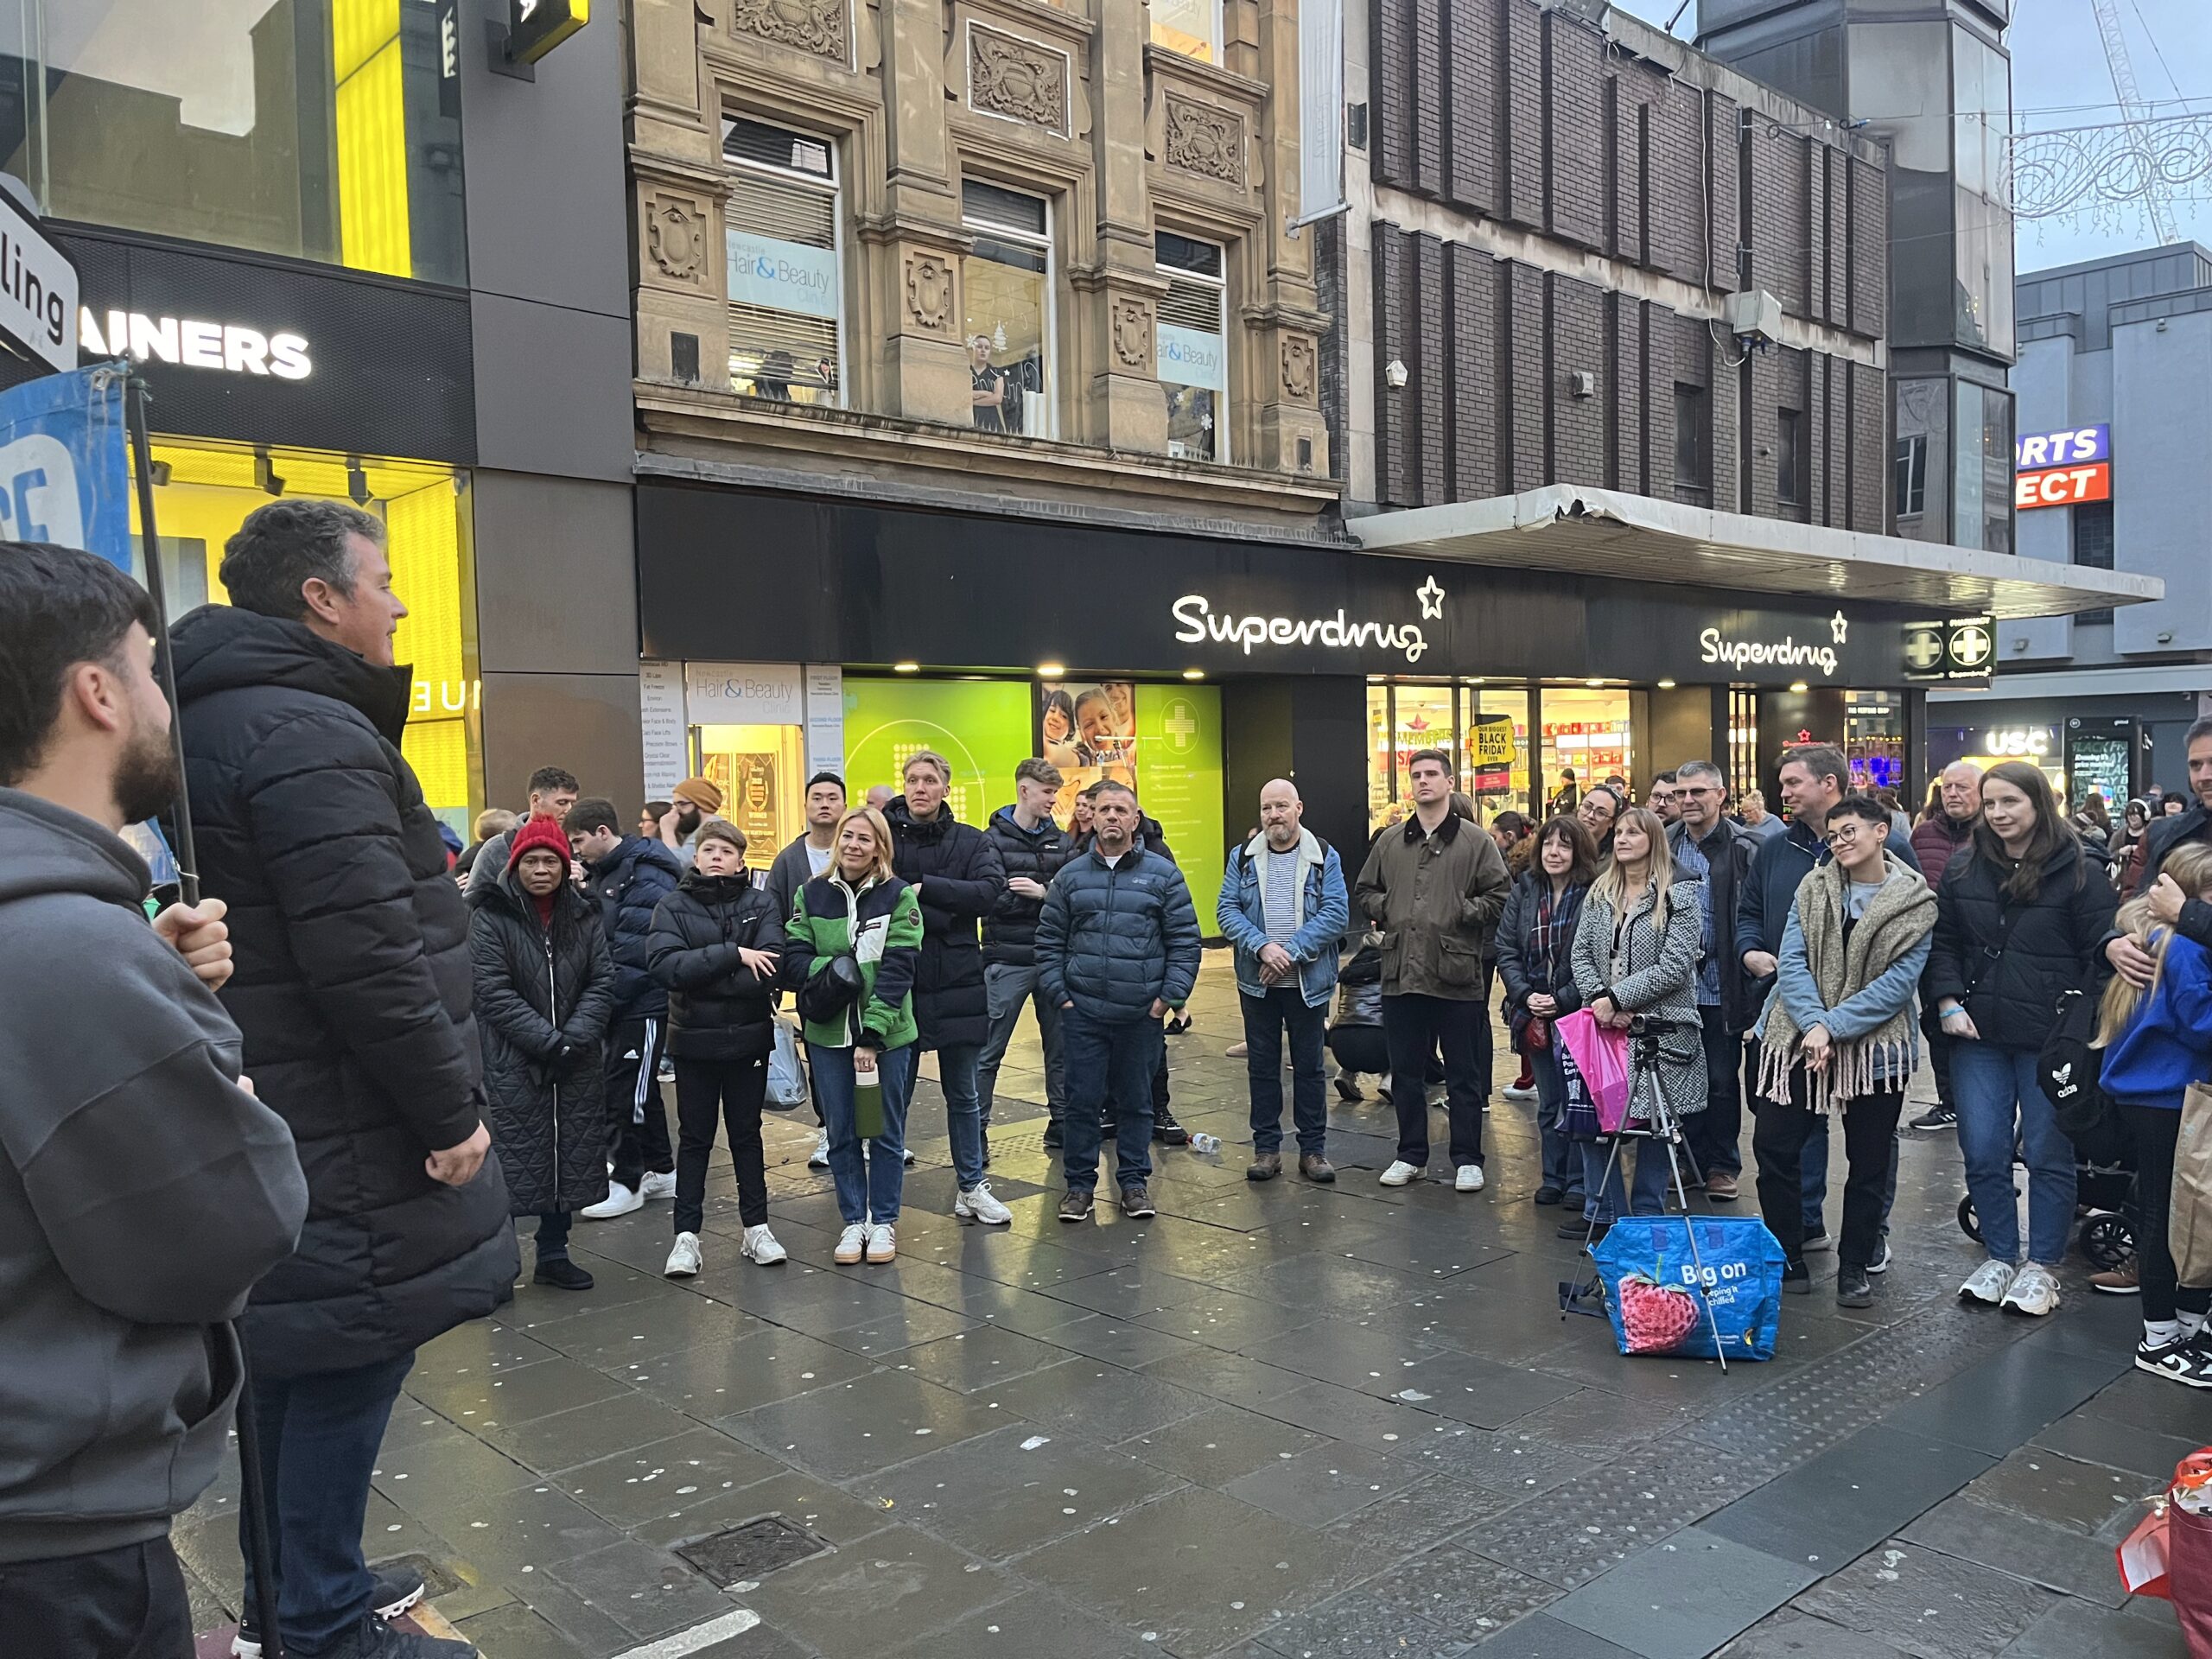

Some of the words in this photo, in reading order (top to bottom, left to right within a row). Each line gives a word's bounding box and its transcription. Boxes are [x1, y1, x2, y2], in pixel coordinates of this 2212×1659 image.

[779, 259, 830, 294] Beauty
[1184, 344, 1217, 371] Beauty
[2016, 429, 2098, 466] RTS
[1172, 594, 1427, 663] Superdrug
[1700, 627, 1838, 677] Superdrug
[696, 678, 724, 699] Hair
[745, 678, 793, 702] Beauty
[1479, 733, 1506, 744] BLACK
[1479, 745, 1506, 755] FRIDAY
[1986, 731, 2049, 755] USC
[1681, 1264, 1718, 1287] Big
[1720, 1262, 1746, 1279] on
